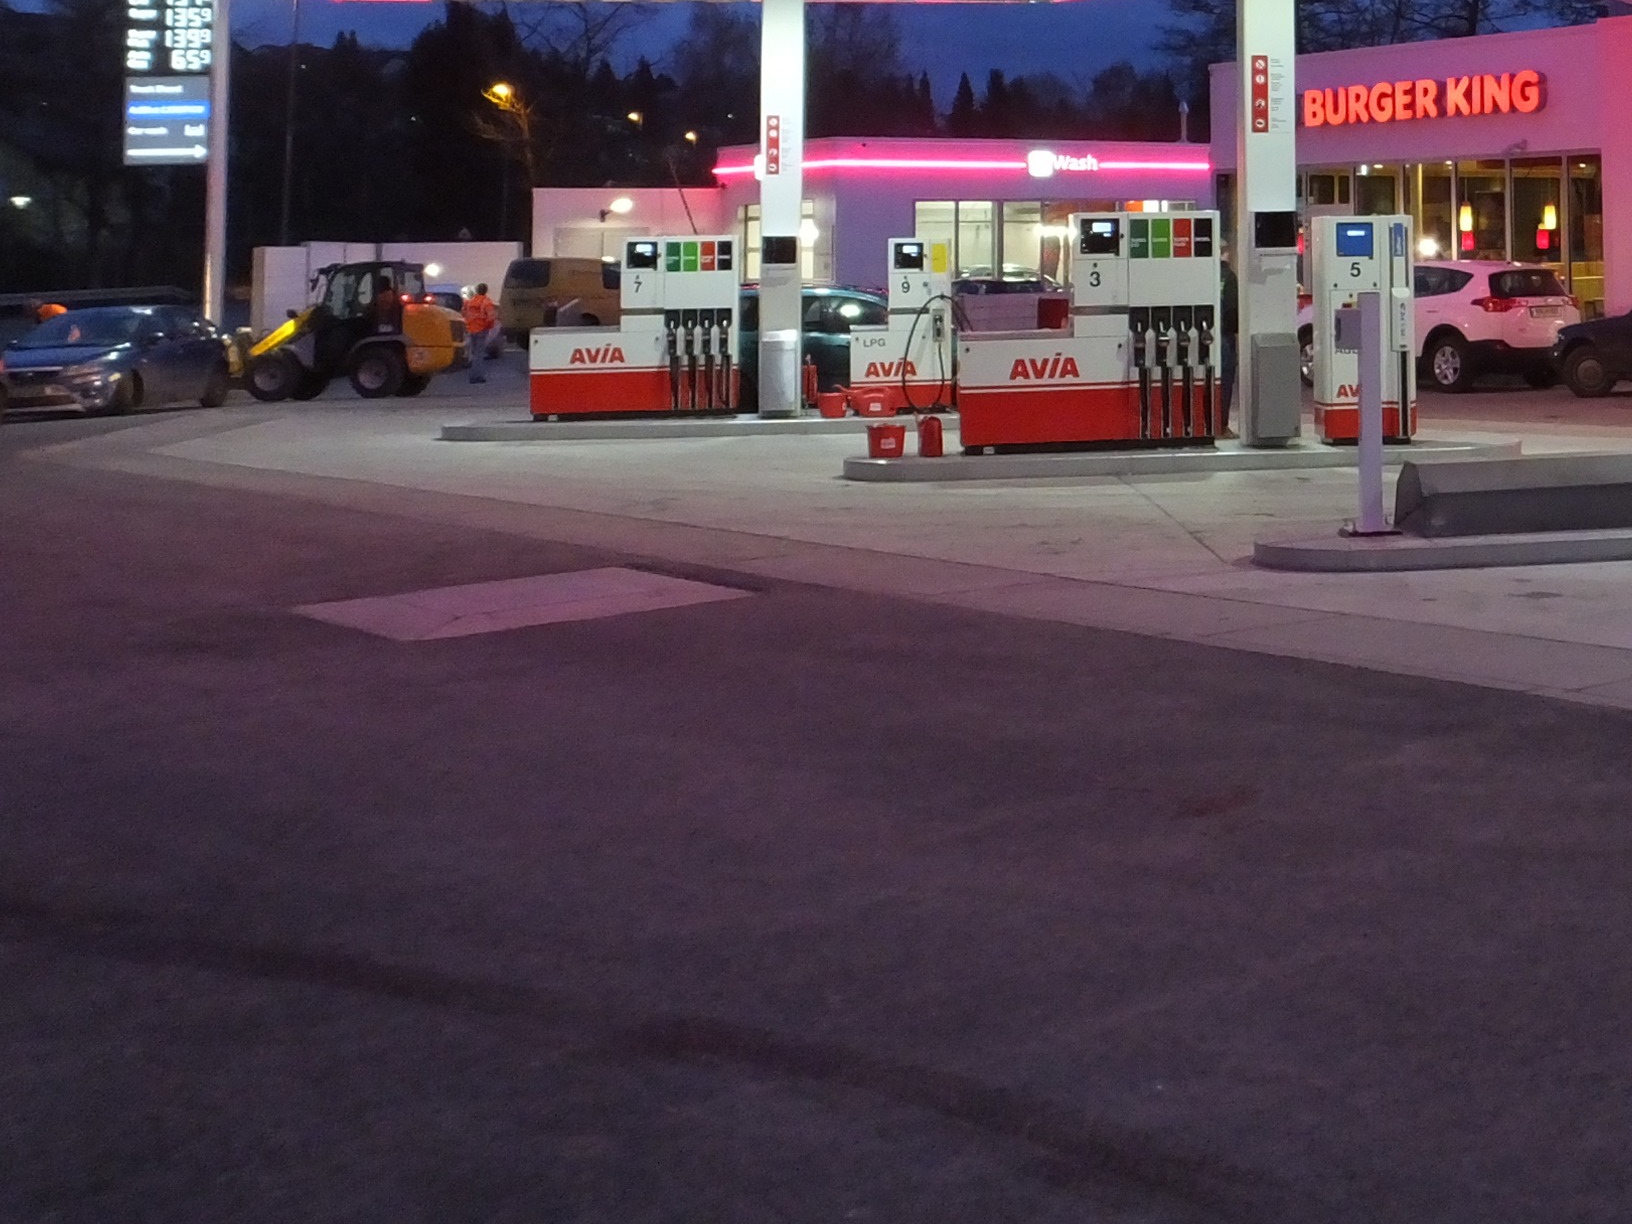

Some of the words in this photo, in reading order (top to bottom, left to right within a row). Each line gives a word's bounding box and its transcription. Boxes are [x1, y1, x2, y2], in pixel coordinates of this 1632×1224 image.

[1303, 78, 1439, 127] BURGER
[1446, 69, 1541, 117] KING
[1053, 153, 1099, 172] Wash
[1350, 262, 1362, 278] 5
[634, 281, 643, 293] 7
[901, 281, 911, 294] 9
[1089, 271, 1101, 288] 3
[863, 337, 886, 348] LPG
[1009, 352, 1080, 380] AVIA
